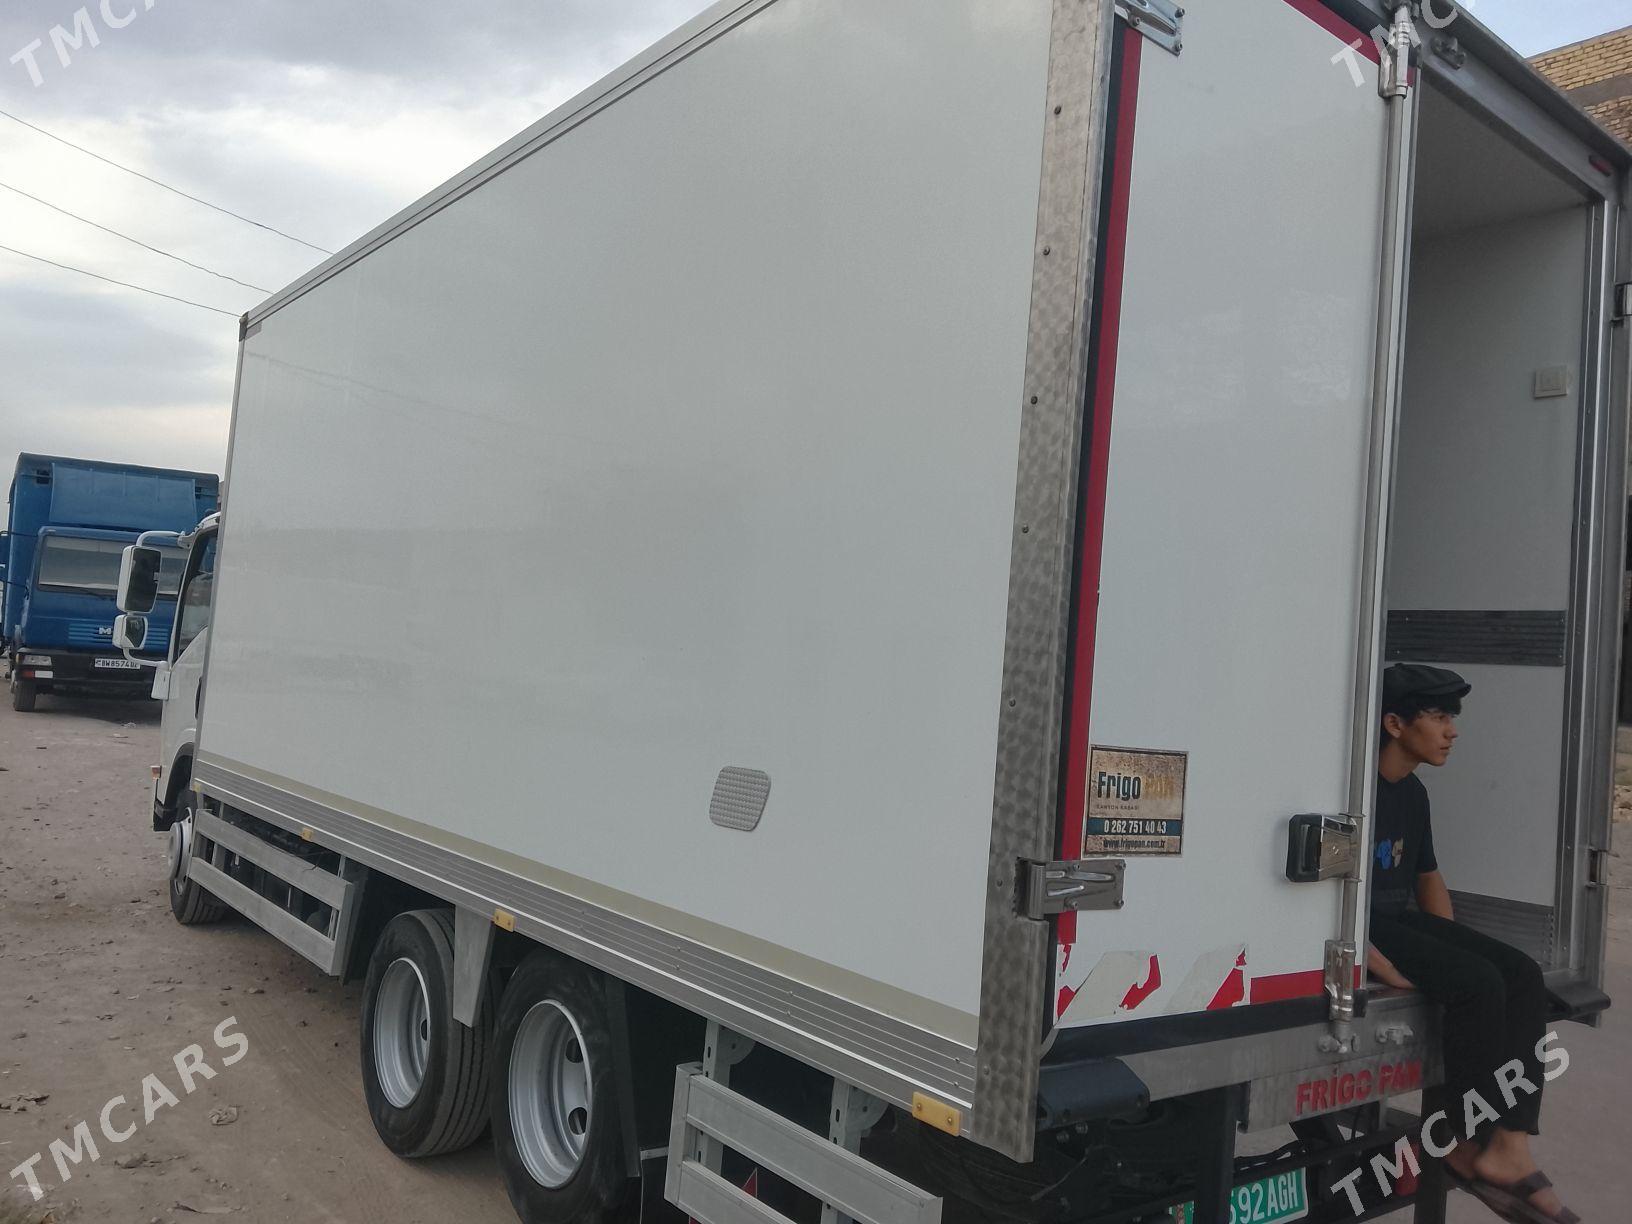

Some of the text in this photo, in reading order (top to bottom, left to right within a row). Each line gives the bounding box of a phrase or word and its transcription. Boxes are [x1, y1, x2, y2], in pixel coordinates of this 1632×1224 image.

[1097, 772, 1141, 801] Frigo
[1104, 819, 1167, 834] 0 262 751 40 43
